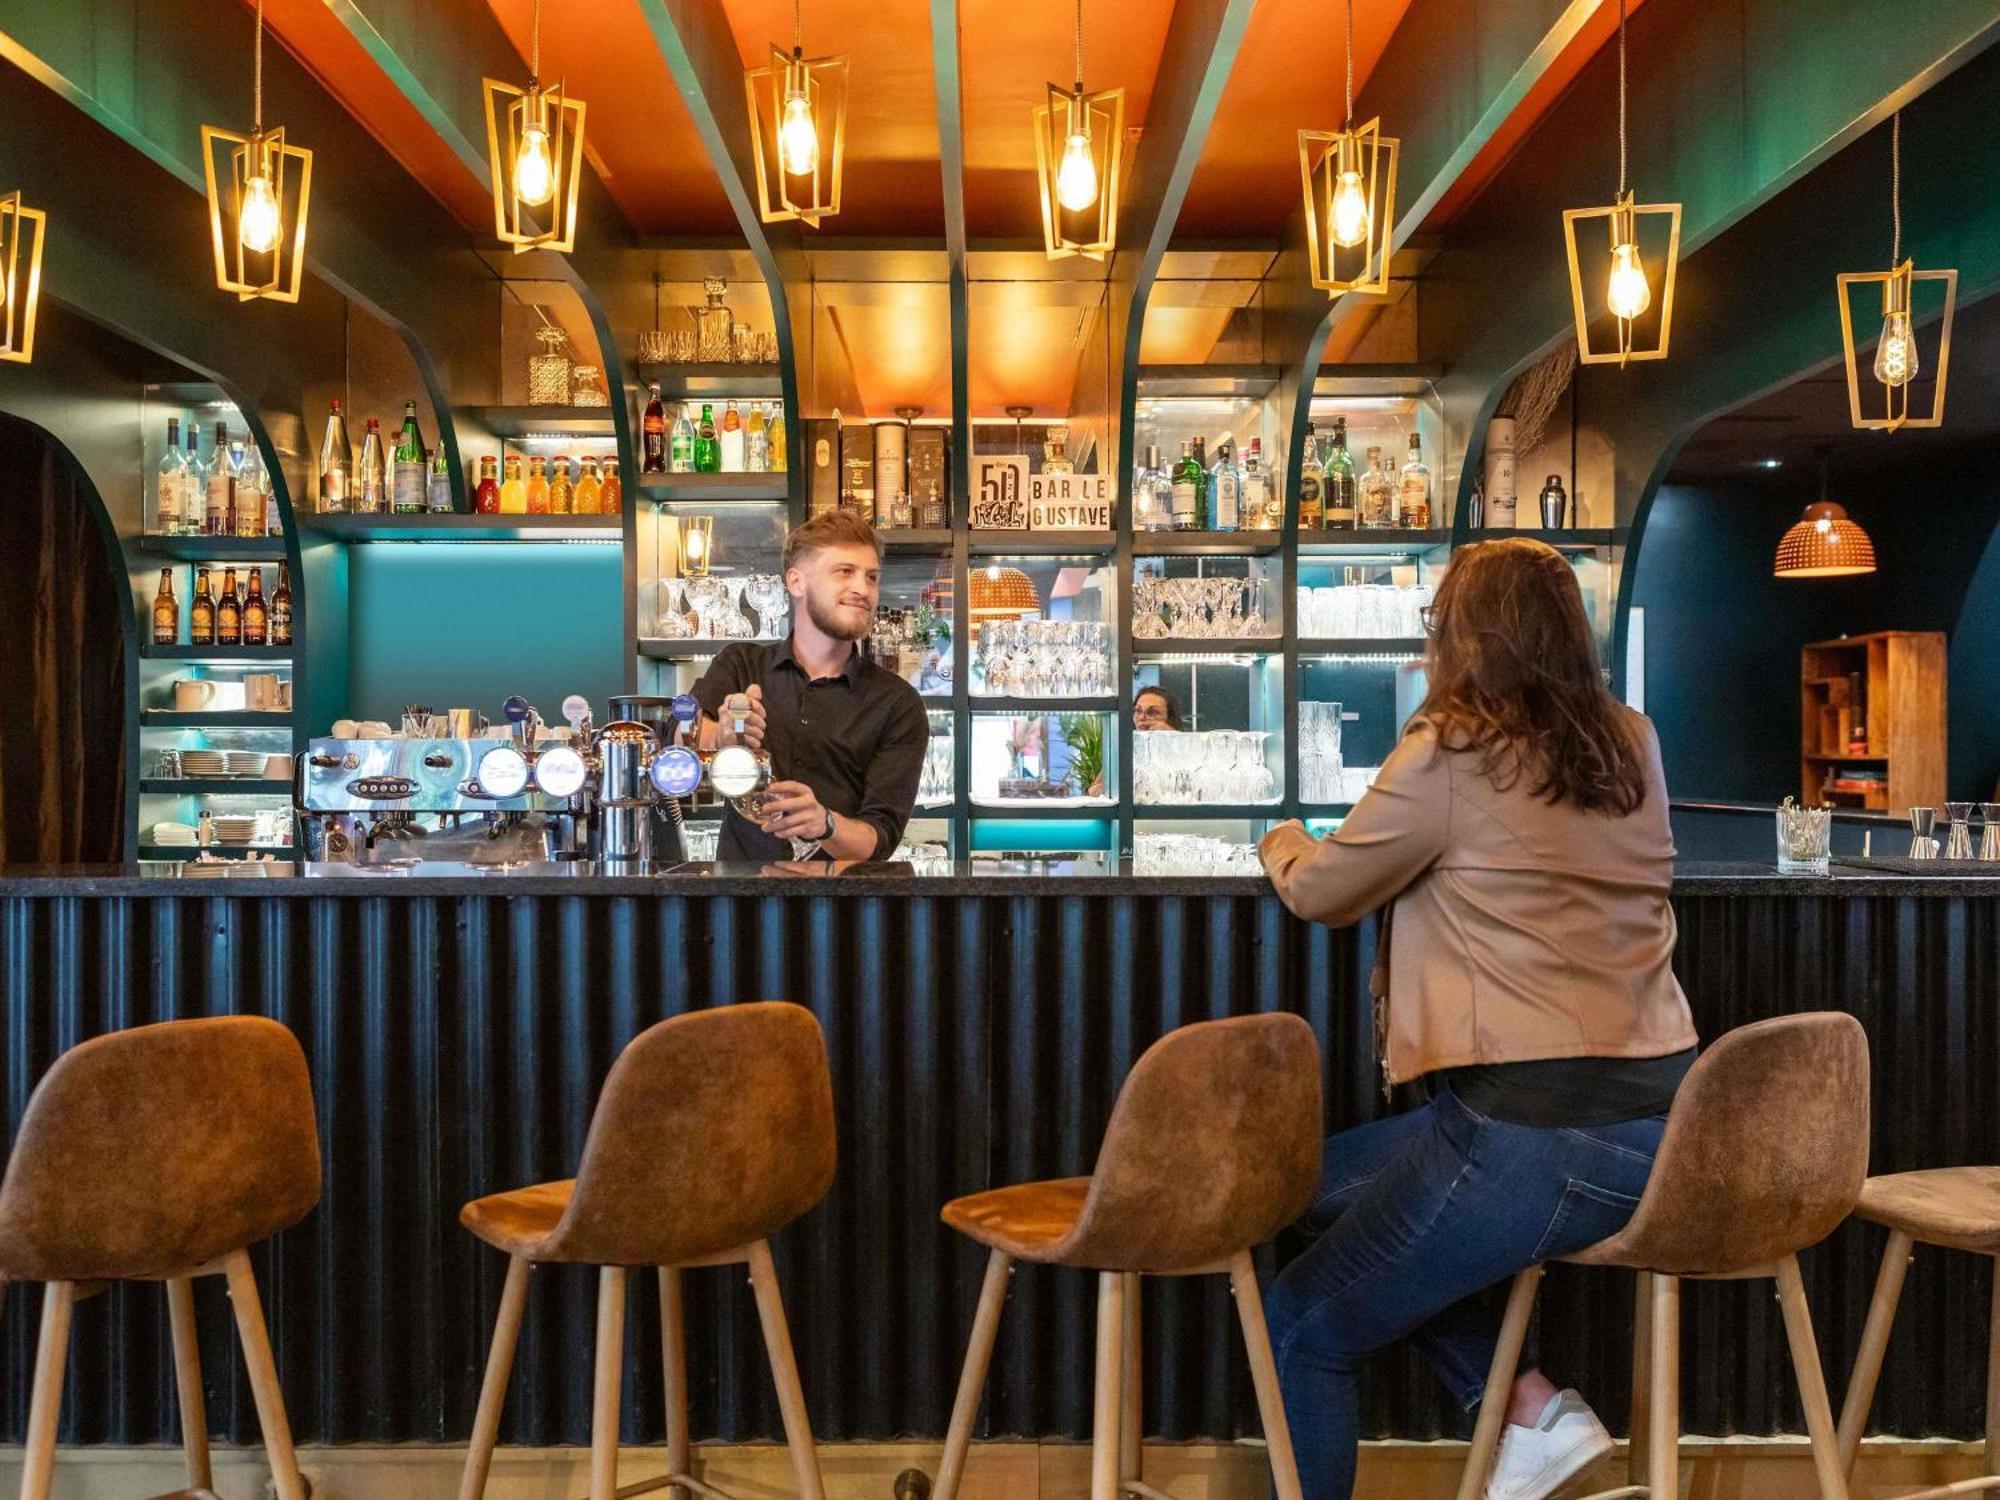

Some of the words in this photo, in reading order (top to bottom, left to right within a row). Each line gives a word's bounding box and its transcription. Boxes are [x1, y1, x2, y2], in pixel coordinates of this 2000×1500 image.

[980, 463, 1020, 501] 50
[1033, 479, 1070, 499] BAR
[1083, 479, 1106, 499] LE
[1033, 506, 1107, 526] GUSTAVE
